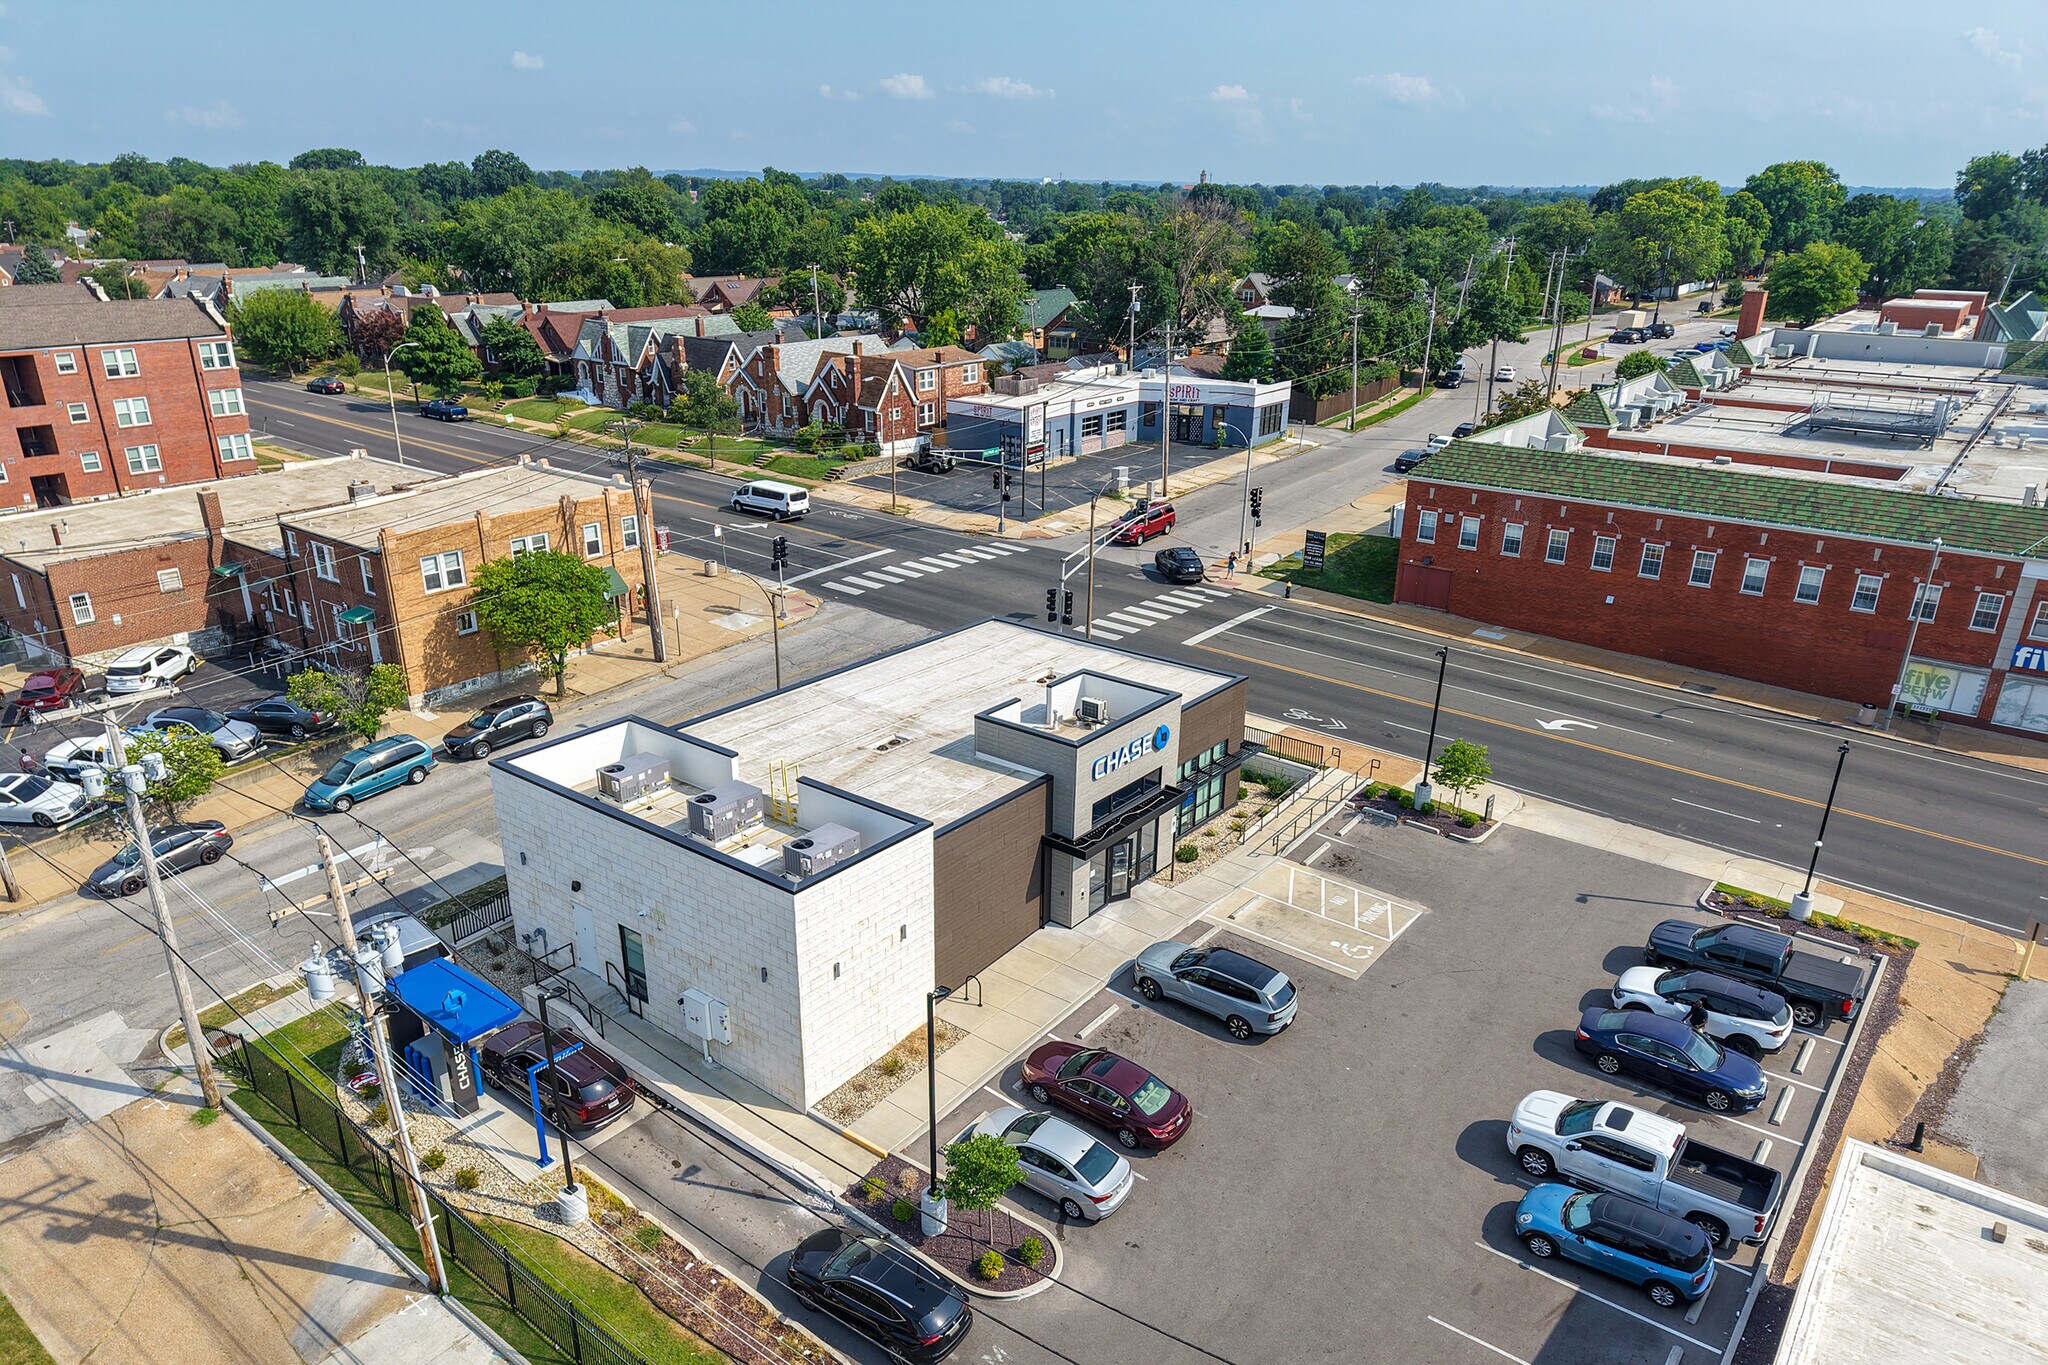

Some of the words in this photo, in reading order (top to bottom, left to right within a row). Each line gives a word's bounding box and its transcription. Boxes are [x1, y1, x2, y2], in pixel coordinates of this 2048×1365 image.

[1169, 384, 1201, 399] SPIRIT
[973, 405, 993, 416] SPIRIT
[2015, 646, 2048, 672] fi
[1905, 669, 1951, 691] five
[1902, 683, 1948, 701] BELOW
[1092, 732, 1153, 782] CHASE
[1329, 895, 1348, 906] NO
[1357, 902, 1388, 925] PARKING
[453, 1042, 471, 1090] CHASE
